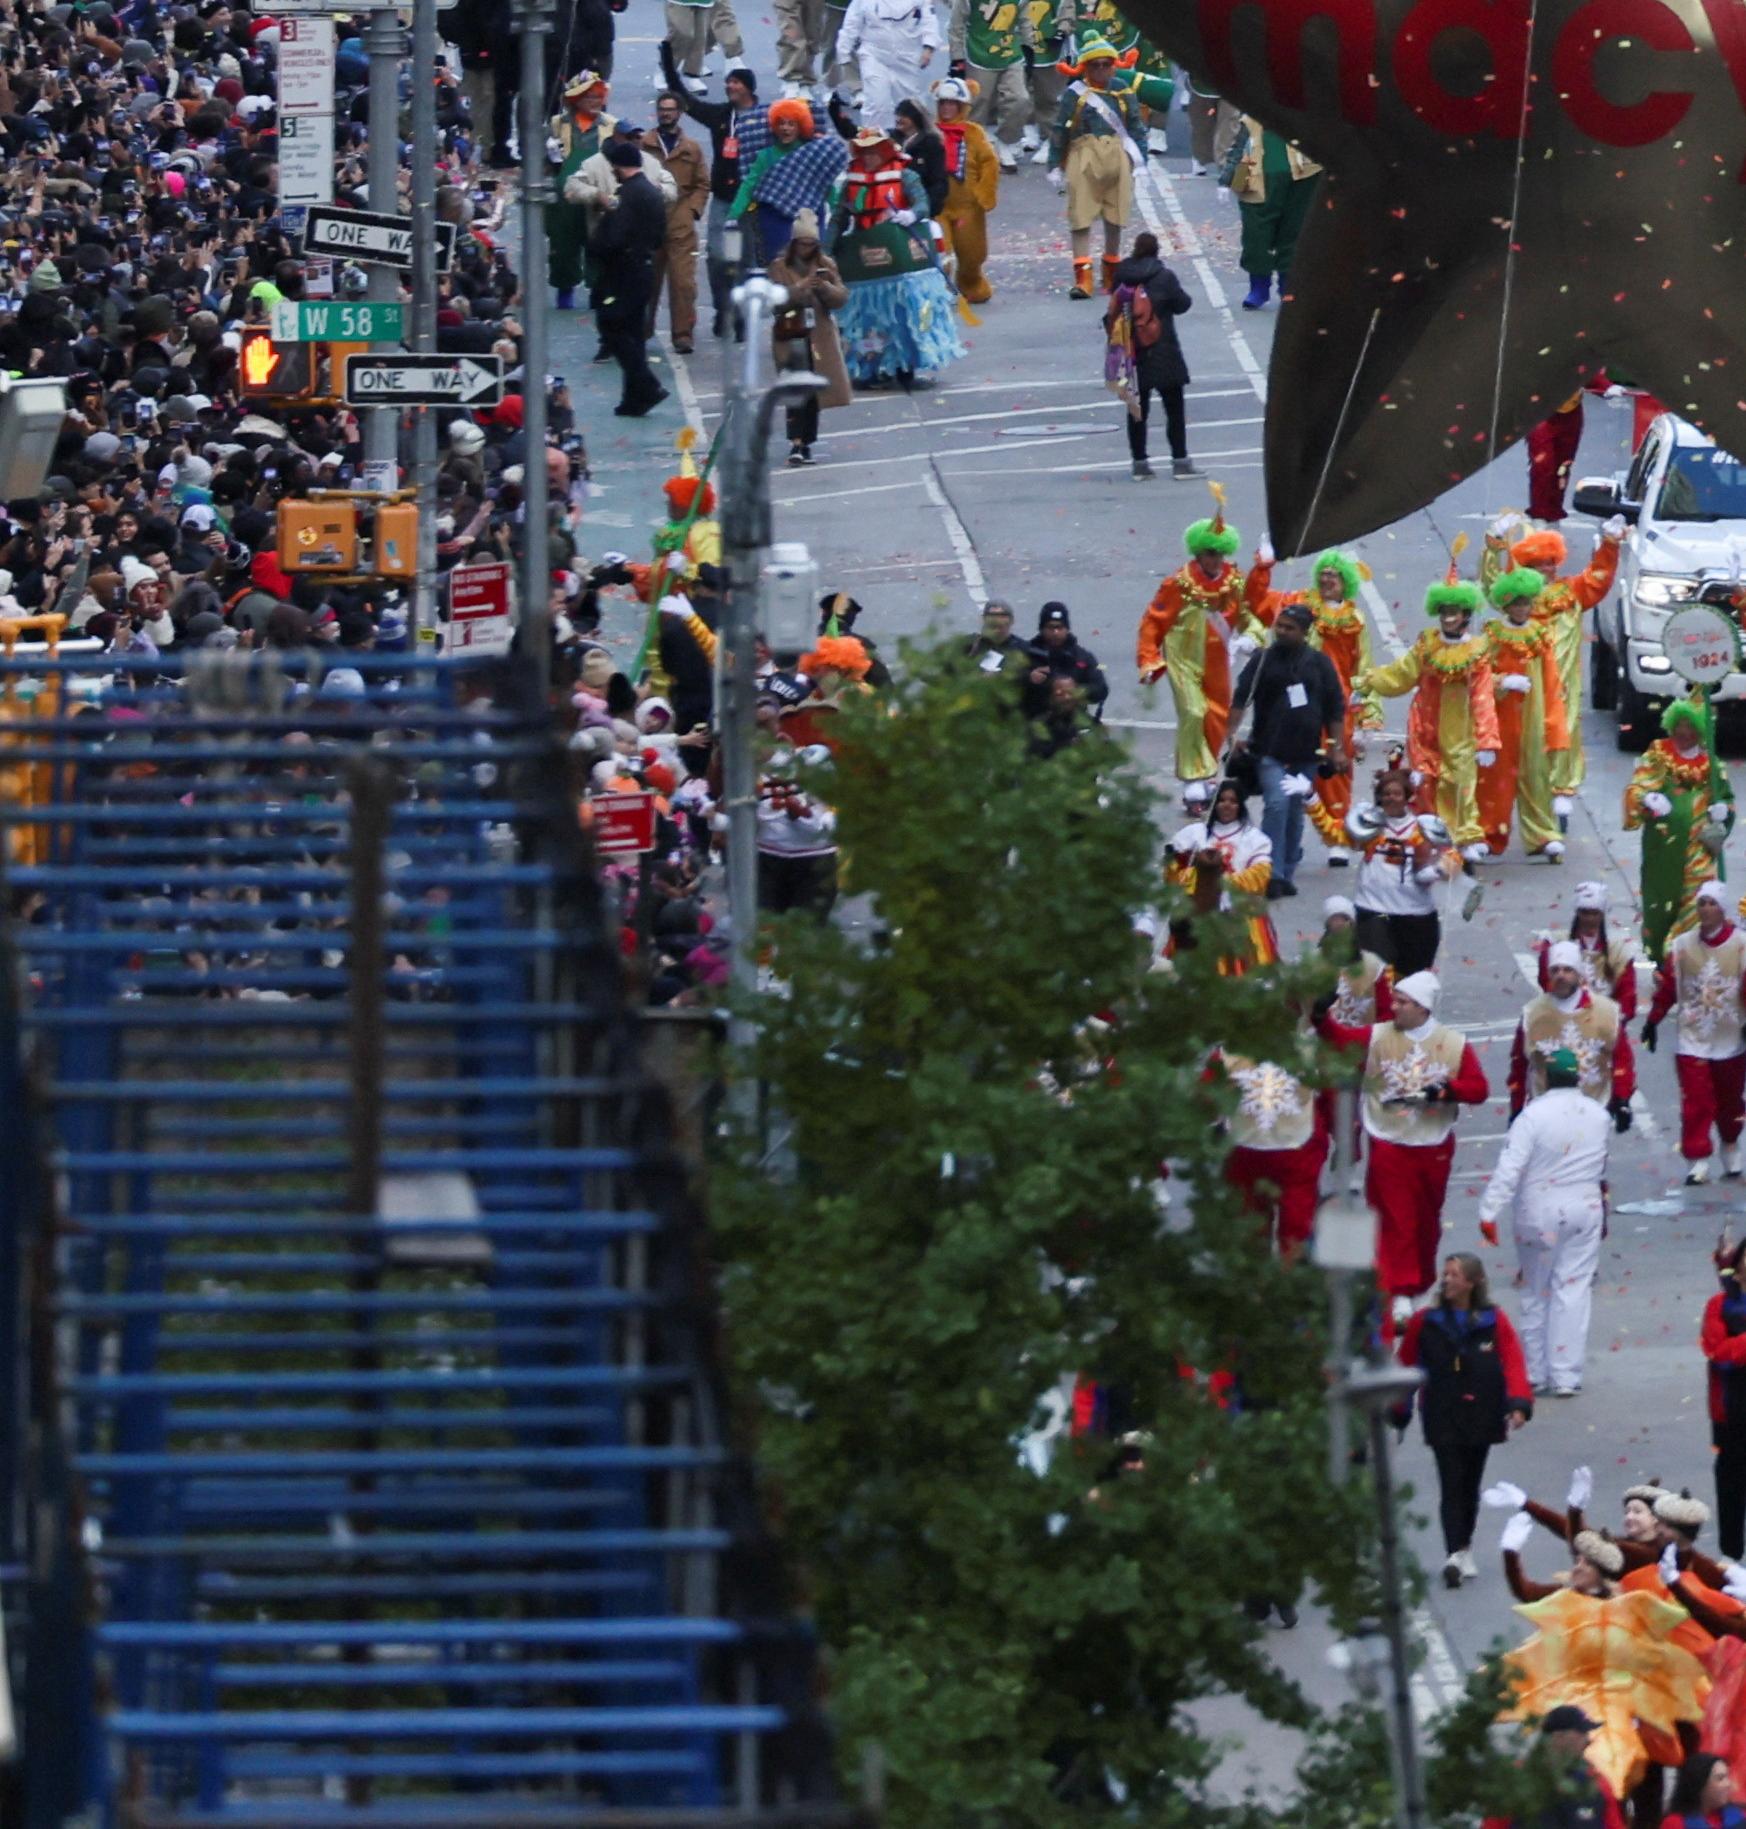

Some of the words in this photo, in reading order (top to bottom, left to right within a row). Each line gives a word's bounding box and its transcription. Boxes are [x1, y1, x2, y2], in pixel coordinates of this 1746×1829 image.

[283, 22, 293, 41] 3
[283, 118, 294, 137] 5
[327, 223, 369, 245] ONE
[388, 232, 413, 251] WA
[305, 307, 328, 336] W
[341, 307, 373, 336] 58
[360, 371, 405, 389] ONE
[433, 372, 480, 389] WAY
